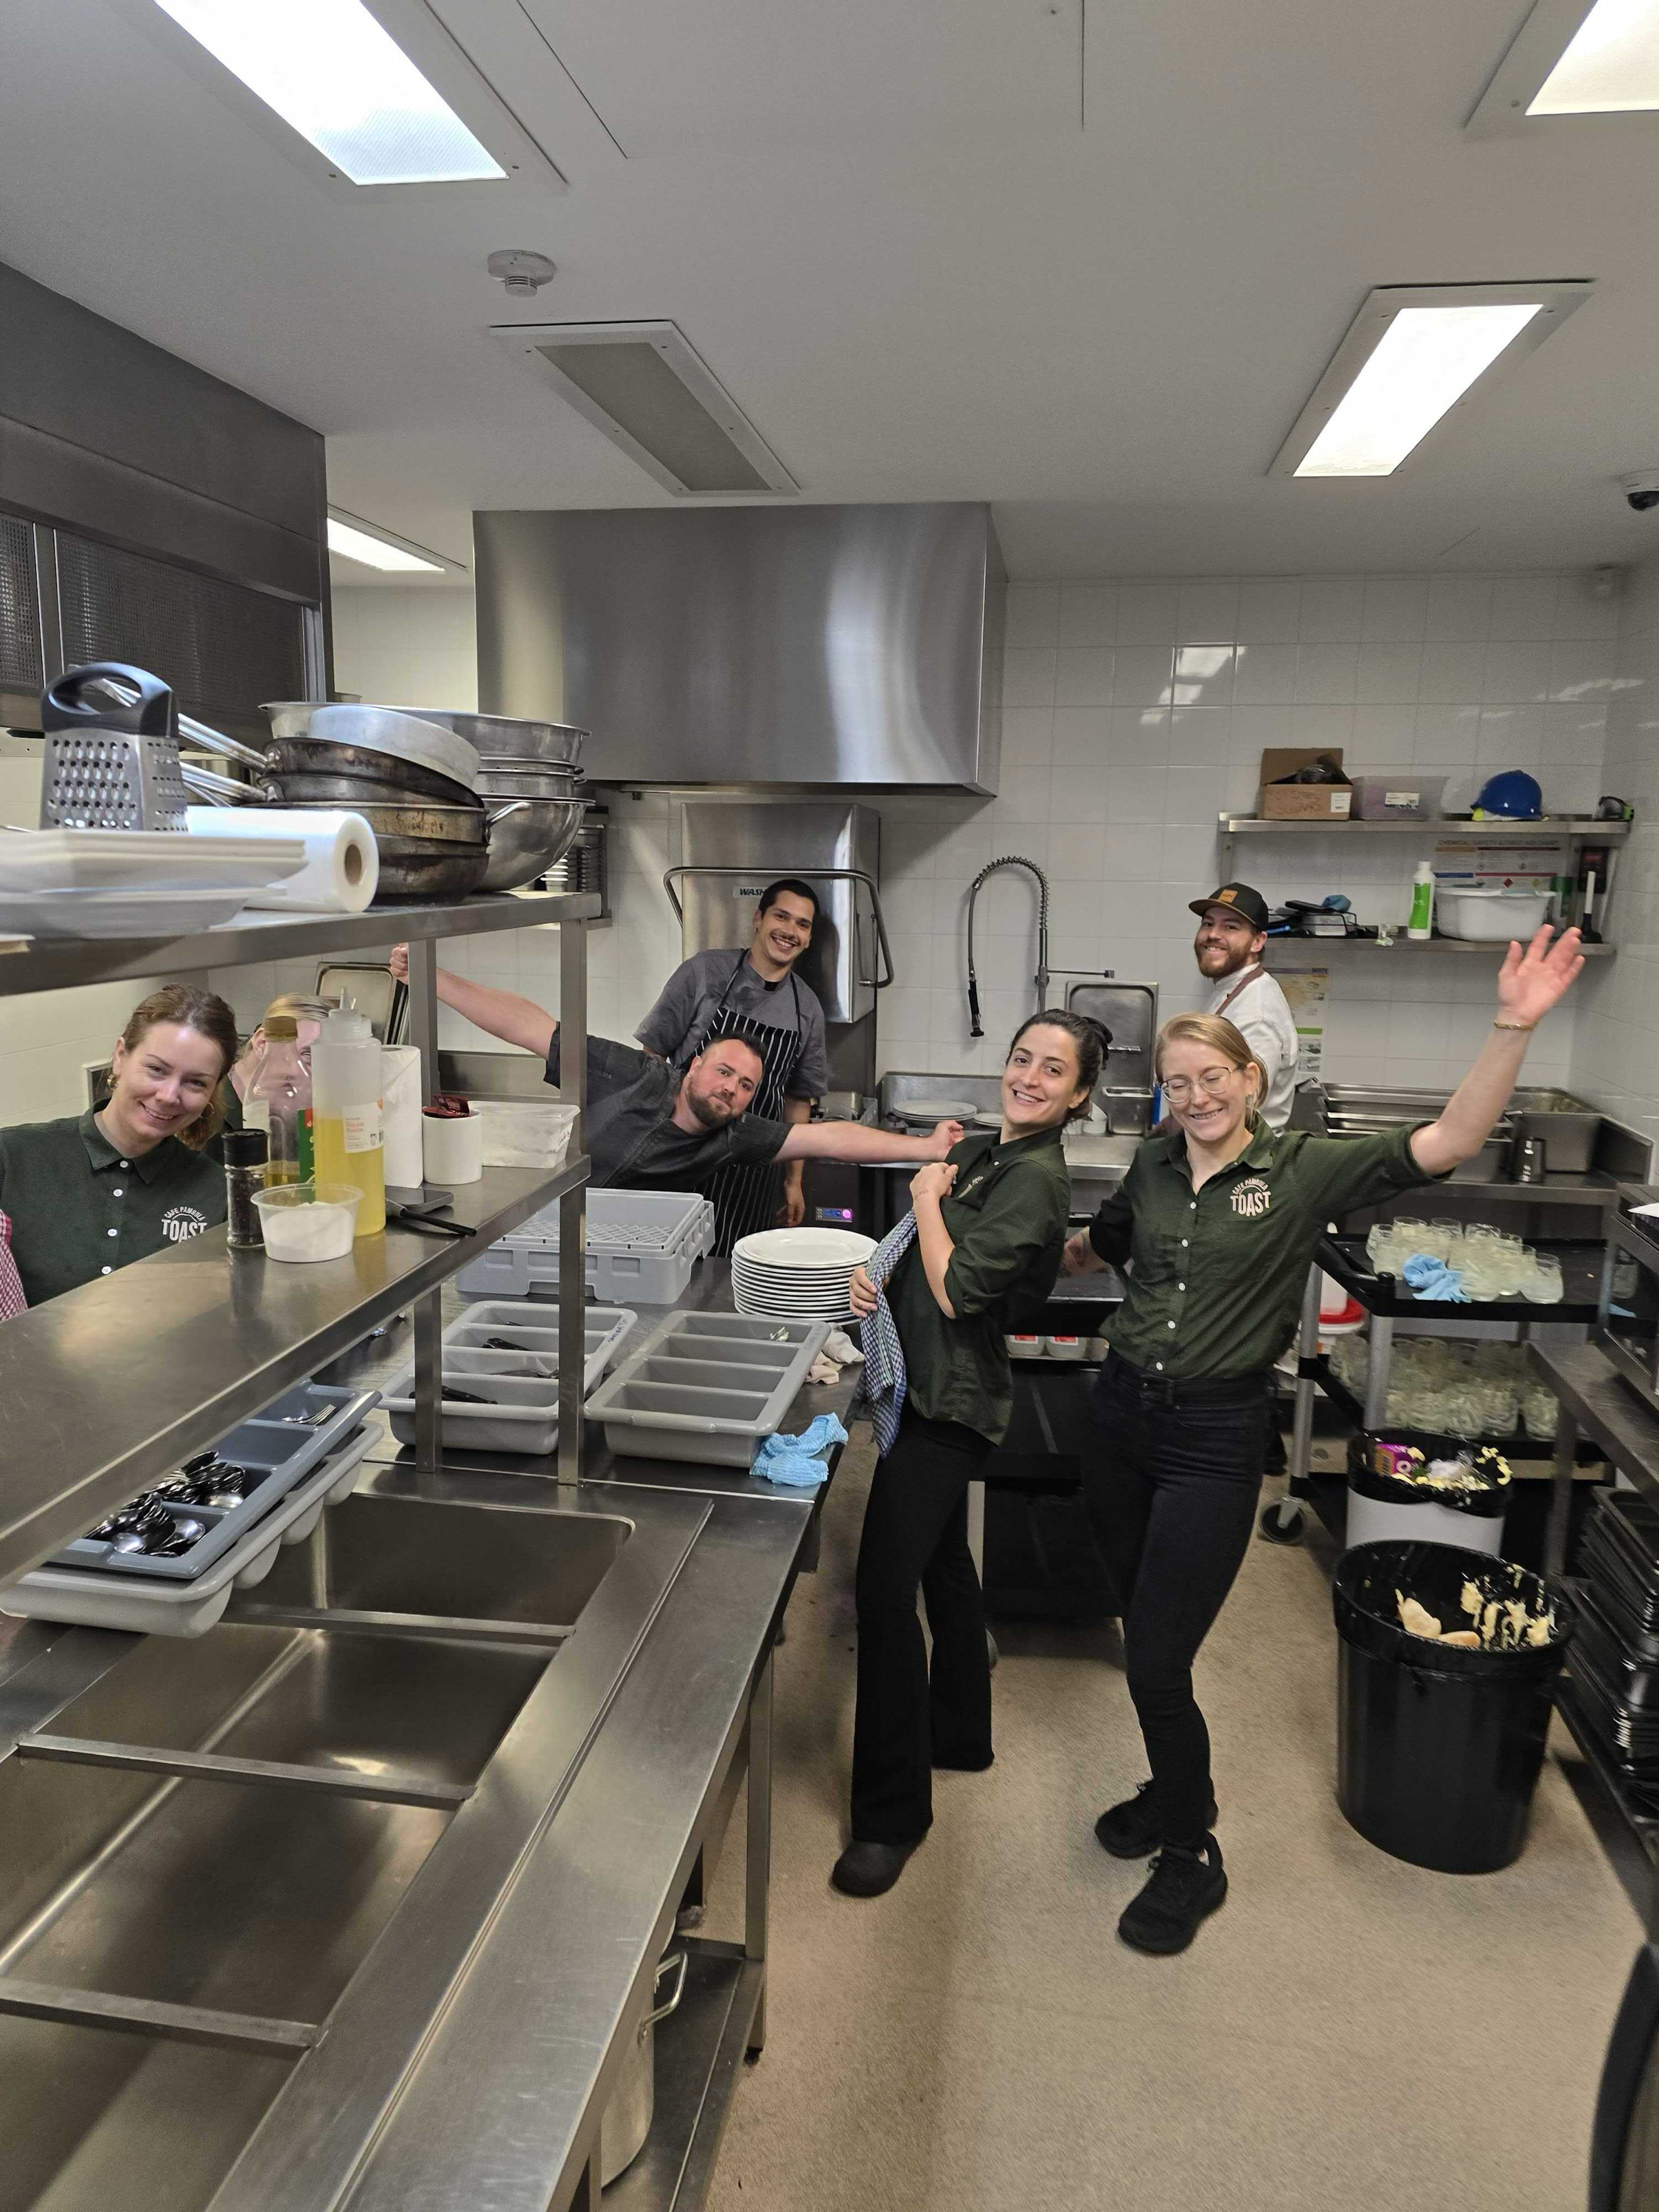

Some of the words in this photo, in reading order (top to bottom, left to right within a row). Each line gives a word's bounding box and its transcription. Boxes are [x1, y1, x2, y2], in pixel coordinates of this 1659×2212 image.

[1232, 1183, 1245, 1194] CAFE
[164, 1207, 180, 1219] CAFE
[180, 1206, 206, 1222] PAMBULA
[1230, 1191, 1271, 1217] TOAST
[161, 1219, 207, 1243] TOAST
